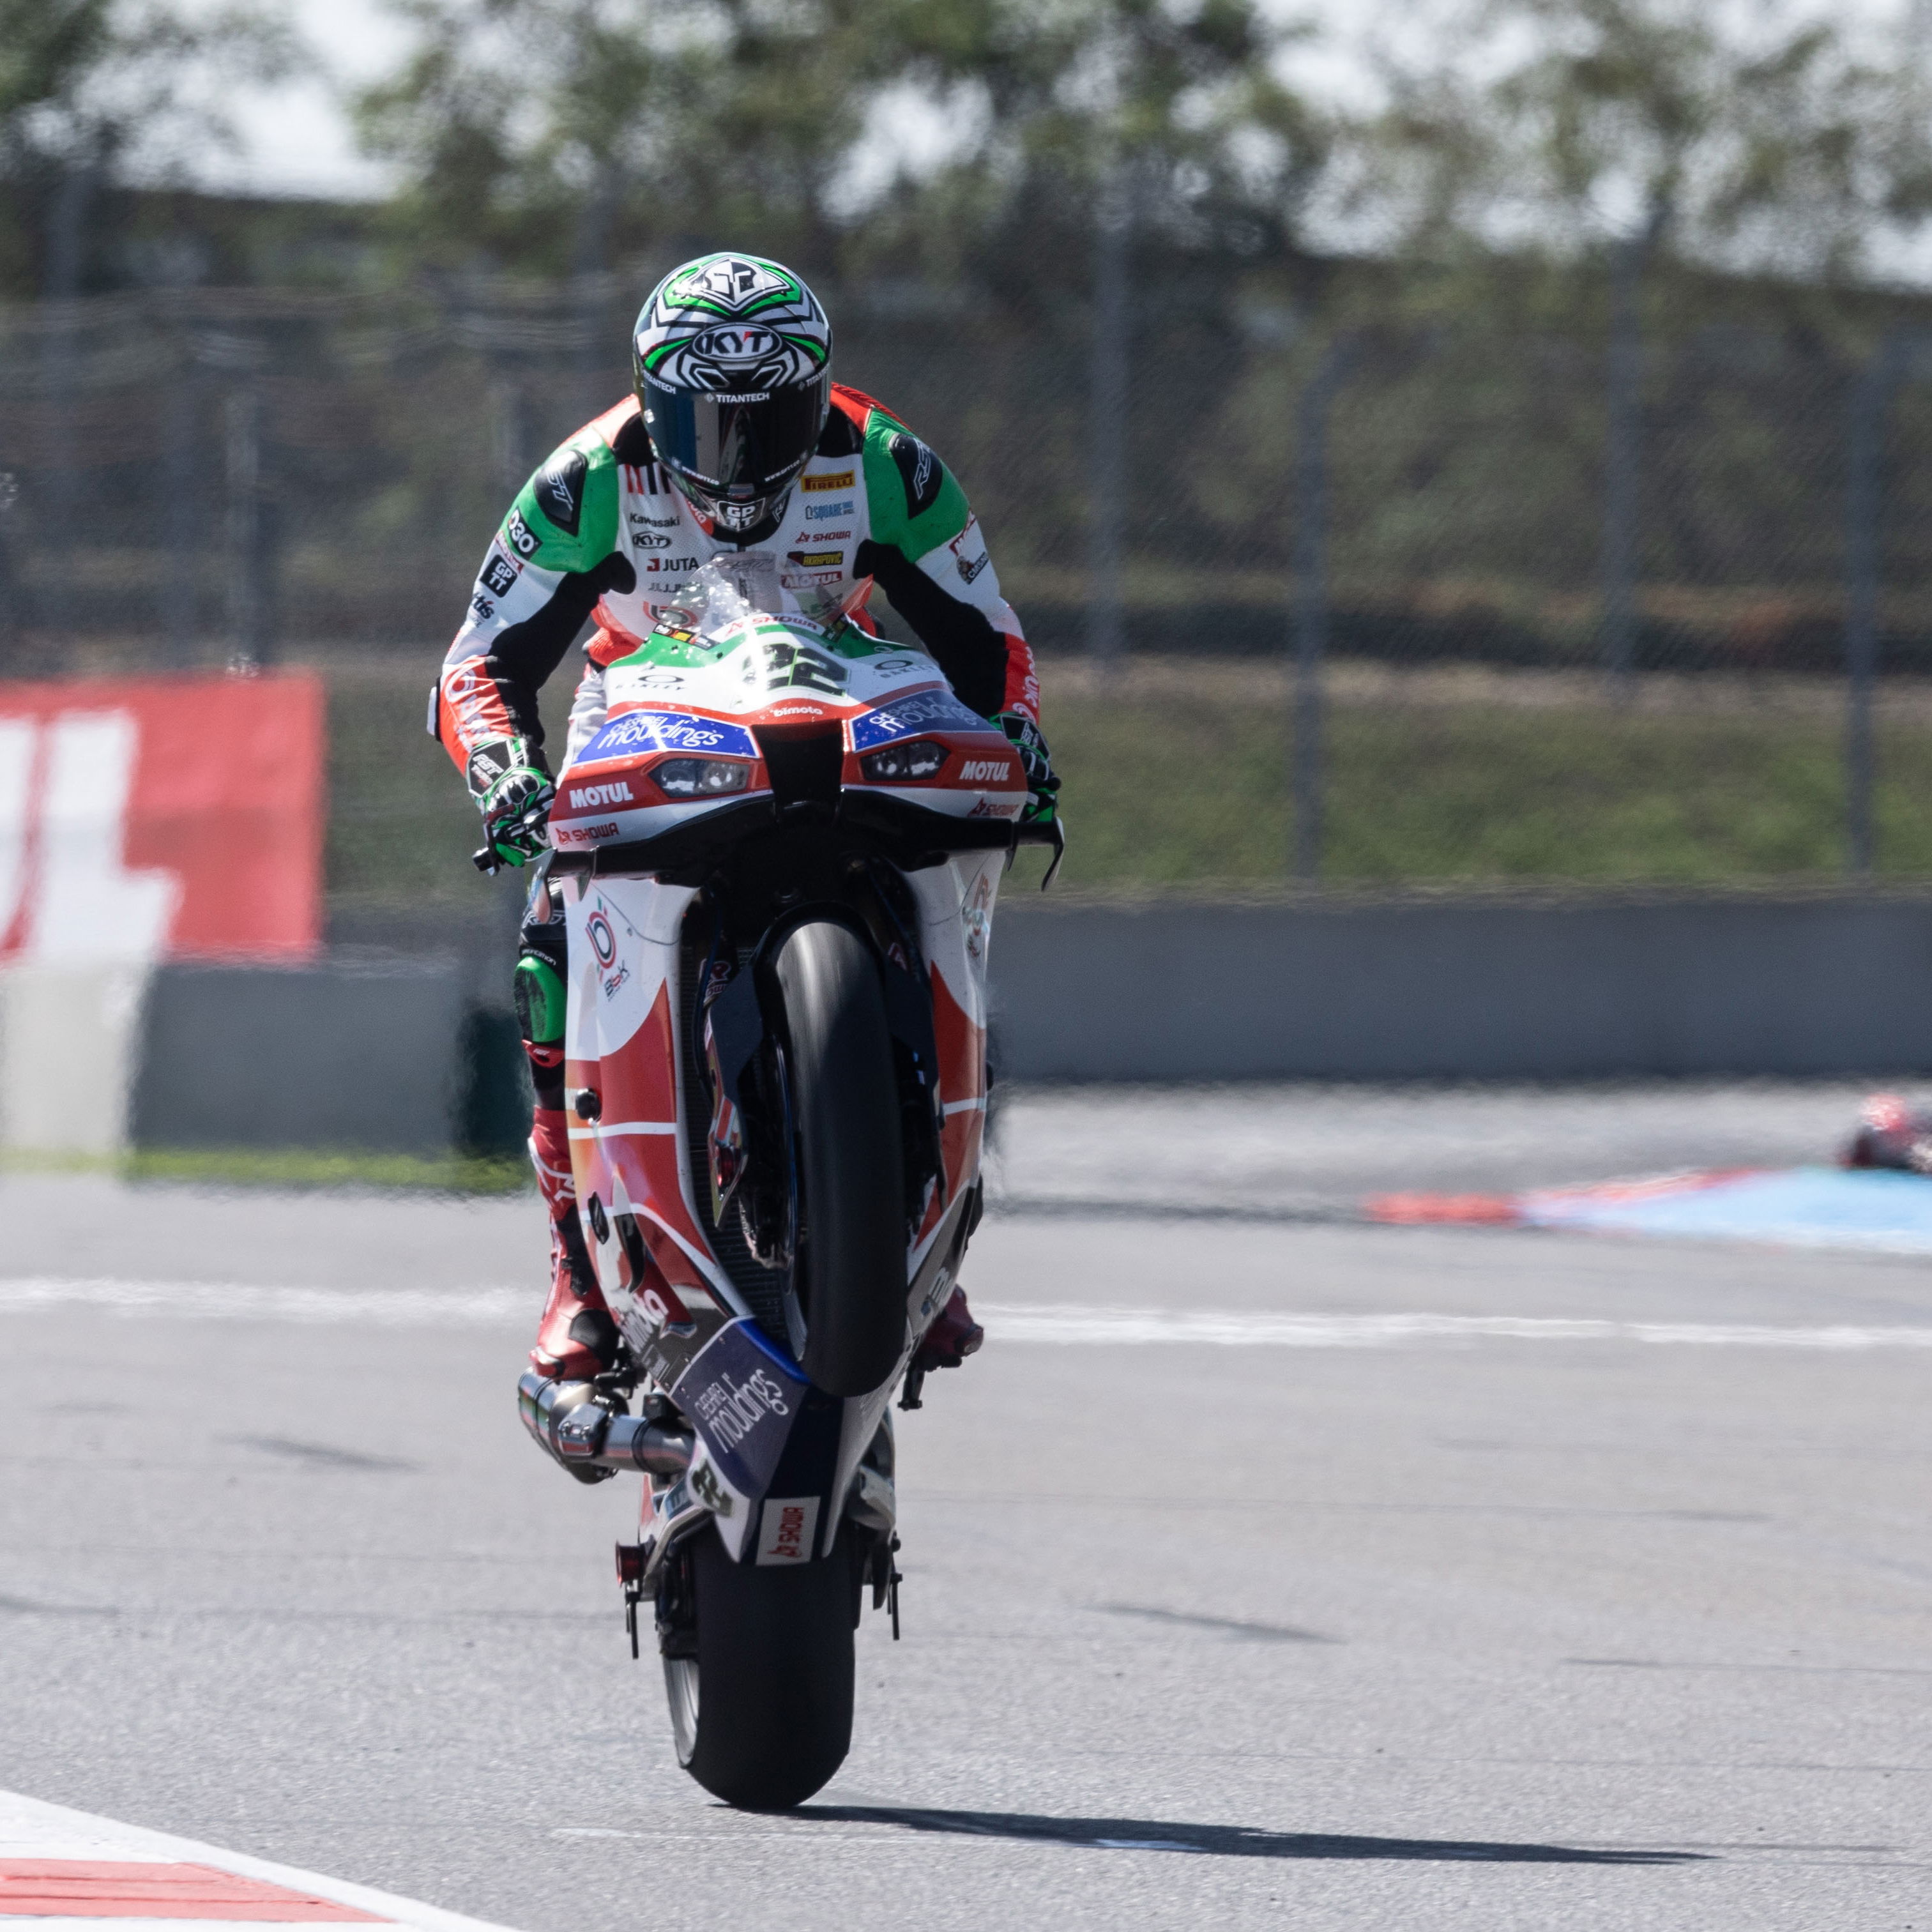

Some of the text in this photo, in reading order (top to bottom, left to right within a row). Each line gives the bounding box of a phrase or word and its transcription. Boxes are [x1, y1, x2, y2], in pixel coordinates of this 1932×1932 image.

[703, 331, 770, 354] KYT
[716, 392, 770, 403] TITANTECH
[804, 473, 853, 491] PIRELLI
[630, 513, 681, 528] Kawasaki
[727, 505, 756, 518] GP
[812, 531, 851, 542] SHOWA
[495, 561, 513, 579] GP
[662, 557, 699, 572] JUTA
[489, 572, 507, 590] TT
[752, 616, 818, 631] SHOWA
[773, 706, 823, 717] bimota
[598, 717, 724, 749] mouldings
[959, 761, 1010, 781] MOTUL
[569, 782, 634, 809] MOTUL
[575, 823, 619, 841] SHOWA
[777, 1507, 805, 1544] SHOWA
